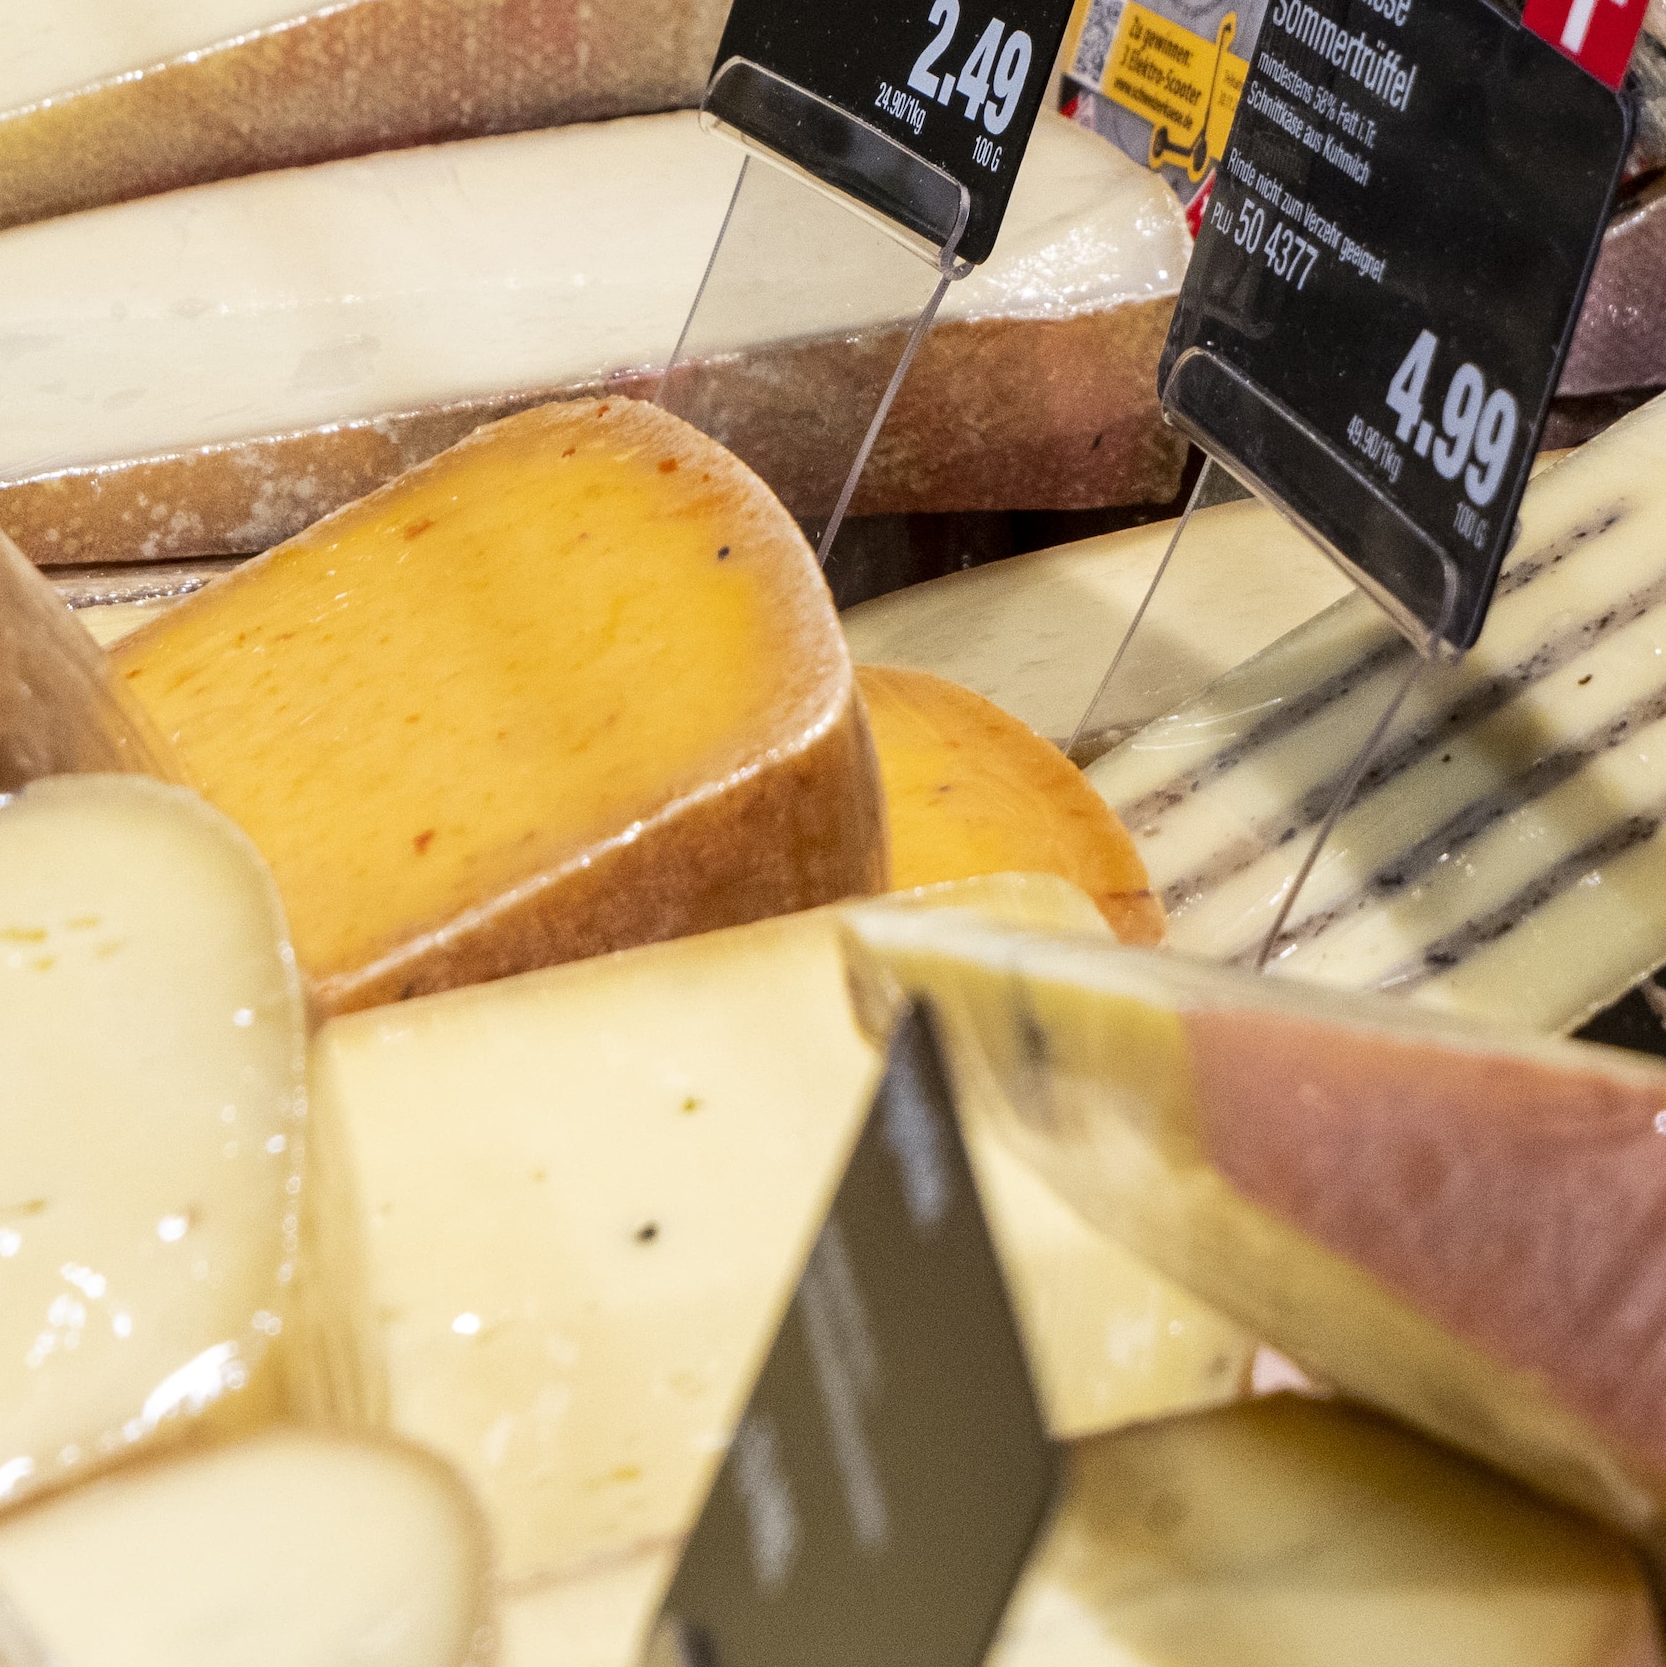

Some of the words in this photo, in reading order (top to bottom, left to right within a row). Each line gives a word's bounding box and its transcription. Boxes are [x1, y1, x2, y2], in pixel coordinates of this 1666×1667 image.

[875, 82, 926, 135] 24.90/1kg
[972, 136, 993, 166] 100
[991, 146, 1002, 172] G
[1247, 81, 1304, 139] Schnittkäse
[1303, 125, 1323, 152] aus
[1322, 134, 1370, 185] Kuhmilch
[1258, 52, 1314, 104] mindestens
[1313, 86, 1337, 120] 58%
[1337, 102, 1359, 136] Fett
[1357, 120, 1377, 148] i.Tr.
[1211, 201, 1233, 234] PLU
[1234, 198, 1265, 254] 50
[1264, 222, 1319, 290] 4377
[1228, 147, 1256, 187] Rinde
[1255, 174, 1282, 206] nicht
[1280, 192, 1304, 221] zum
[1304, 204, 1342, 249] Verzehr
[1339, 237, 1386, 283] geeignet
[1386, 330, 1518, 506] 4.99
[1347, 415, 1402, 483] 49.90/1kg
[1454, 502, 1477, 539] 100
